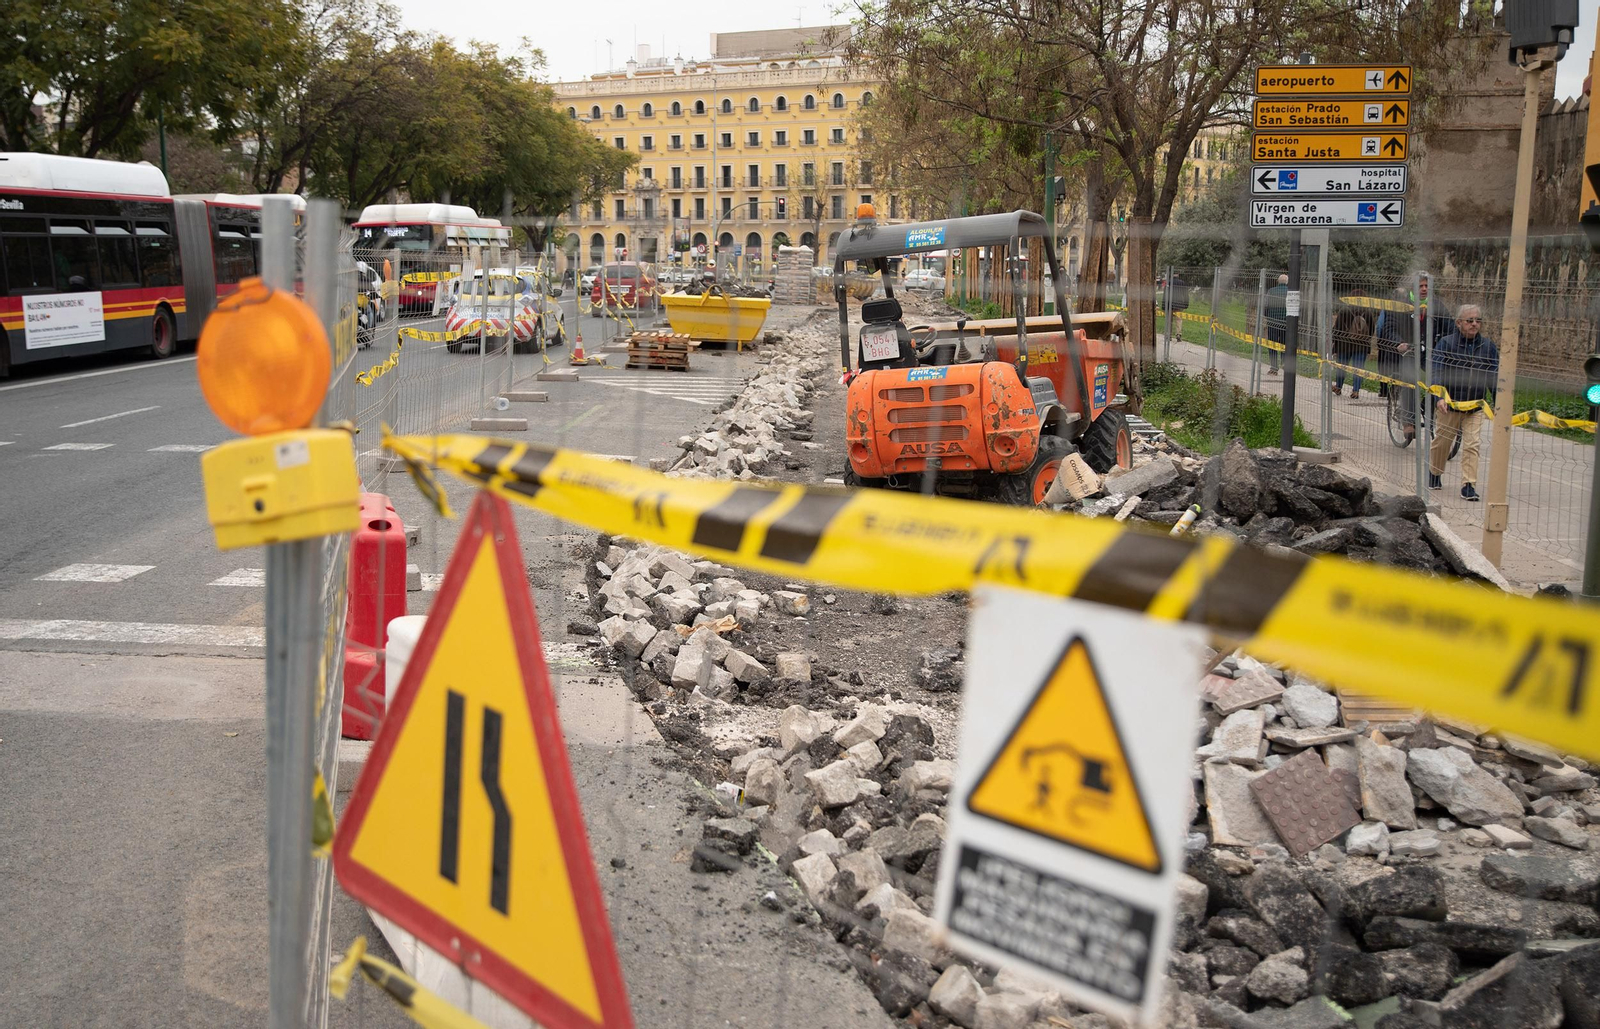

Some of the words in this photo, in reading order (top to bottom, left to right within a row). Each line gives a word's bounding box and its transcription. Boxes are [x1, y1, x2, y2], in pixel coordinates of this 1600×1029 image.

[1260, 76, 1334, 88] aeropuerto
[1260, 105, 1301, 113] estación
[1306, 104, 1340, 112] Prado
[1260, 116, 1282, 124] San
[1289, 115, 1348, 124] Sebastián
[1258, 148, 1296, 157] Santa
[1304, 147, 1340, 157] Justa
[1362, 169, 1402, 178] hospital
[1326, 180, 1351, 190] San
[1358, 180, 1400, 190] Lázaro
[1256, 203, 1295, 214] Virgen
[1302, 204, 1316, 212] de
[1256, 215, 1266, 224] la
[1274, 214, 1332, 223] Macarena
[872, 347, 890, 357] BHG
[900, 442, 964, 455] AUSA
[1070, 460, 1084, 484] COSMOS
